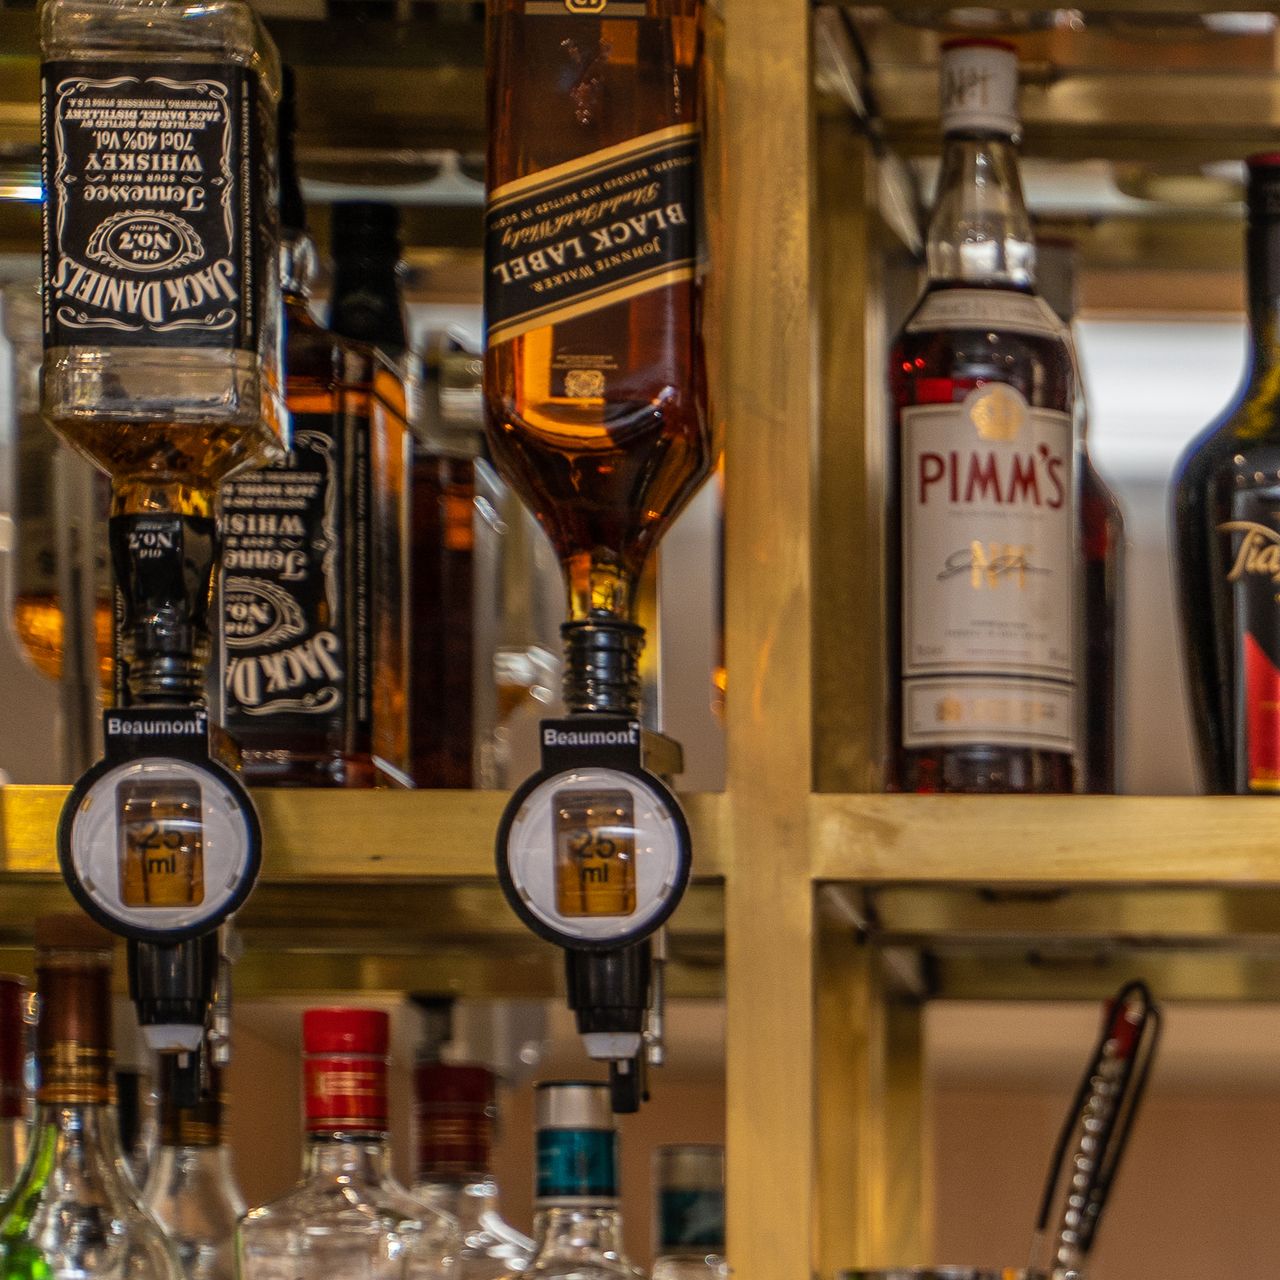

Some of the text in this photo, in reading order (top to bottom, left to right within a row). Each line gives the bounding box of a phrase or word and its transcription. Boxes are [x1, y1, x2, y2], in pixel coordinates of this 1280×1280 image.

[63, 109, 222, 121] JACK DANIEL DISTILLERY
[91, 130, 195, 151] 70cl 40% Vol.
[84, 153, 204, 171] WHISKEY
[83, 185, 206, 212] Tennessee
[491, 202, 688, 285] BLACK LABEL
[51, 255, 239, 323] JACK DANIEL'S
[918, 441, 1067, 510] PIMM'S
[107, 716, 204, 736] Beaumont
[543, 728, 637, 747] Beaumont
[571, 829, 617, 860] 25
[145, 853, 177, 875] ml
[580, 862, 610, 884] ml
